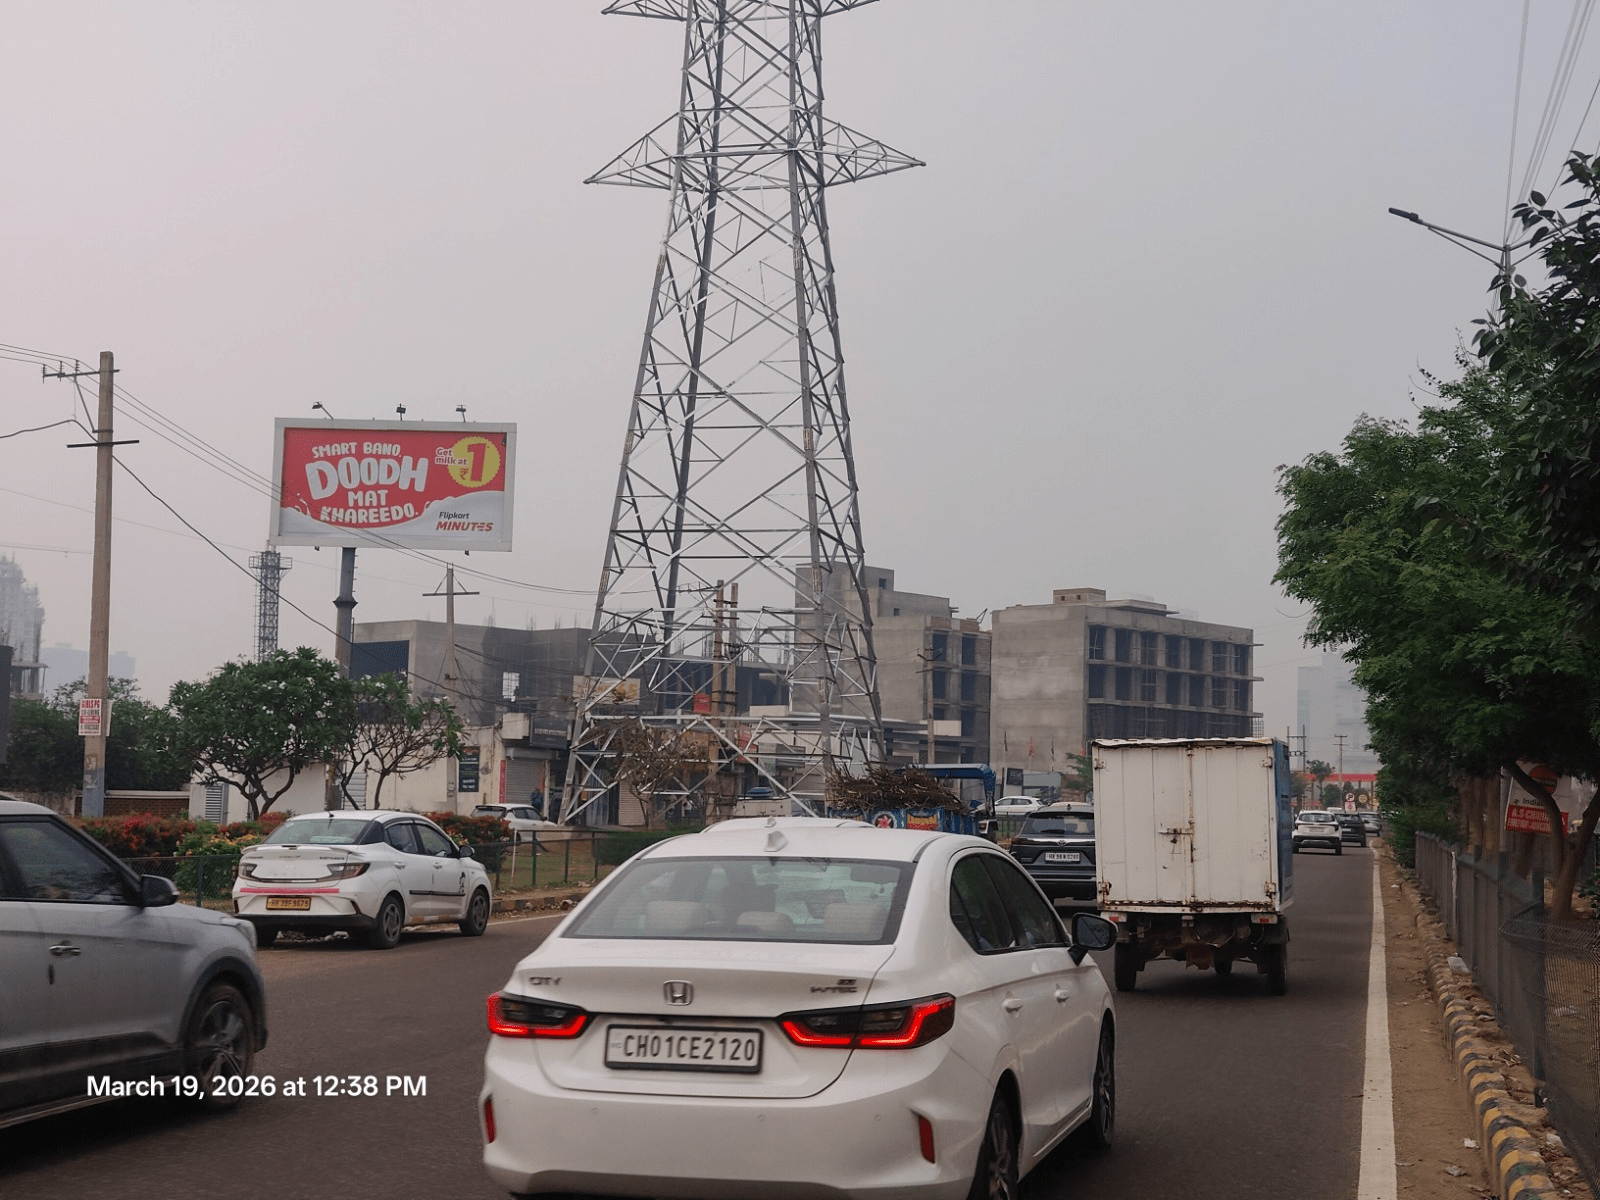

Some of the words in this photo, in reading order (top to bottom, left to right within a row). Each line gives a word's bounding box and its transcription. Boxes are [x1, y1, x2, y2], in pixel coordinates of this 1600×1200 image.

[312, 442, 357, 458] SMART
[436, 448, 453, 457] Get
[435, 457, 456, 465] milk
[305, 456, 429, 500] DOODH
[347, 490, 388, 507] MAT
[320, 503, 419, 524] KHAREEDO.
[439, 511, 469, 520] Flipkart
[436, 521, 493, 532] MINUTES
[624, 1034, 755, 1061] CH01CE2120
